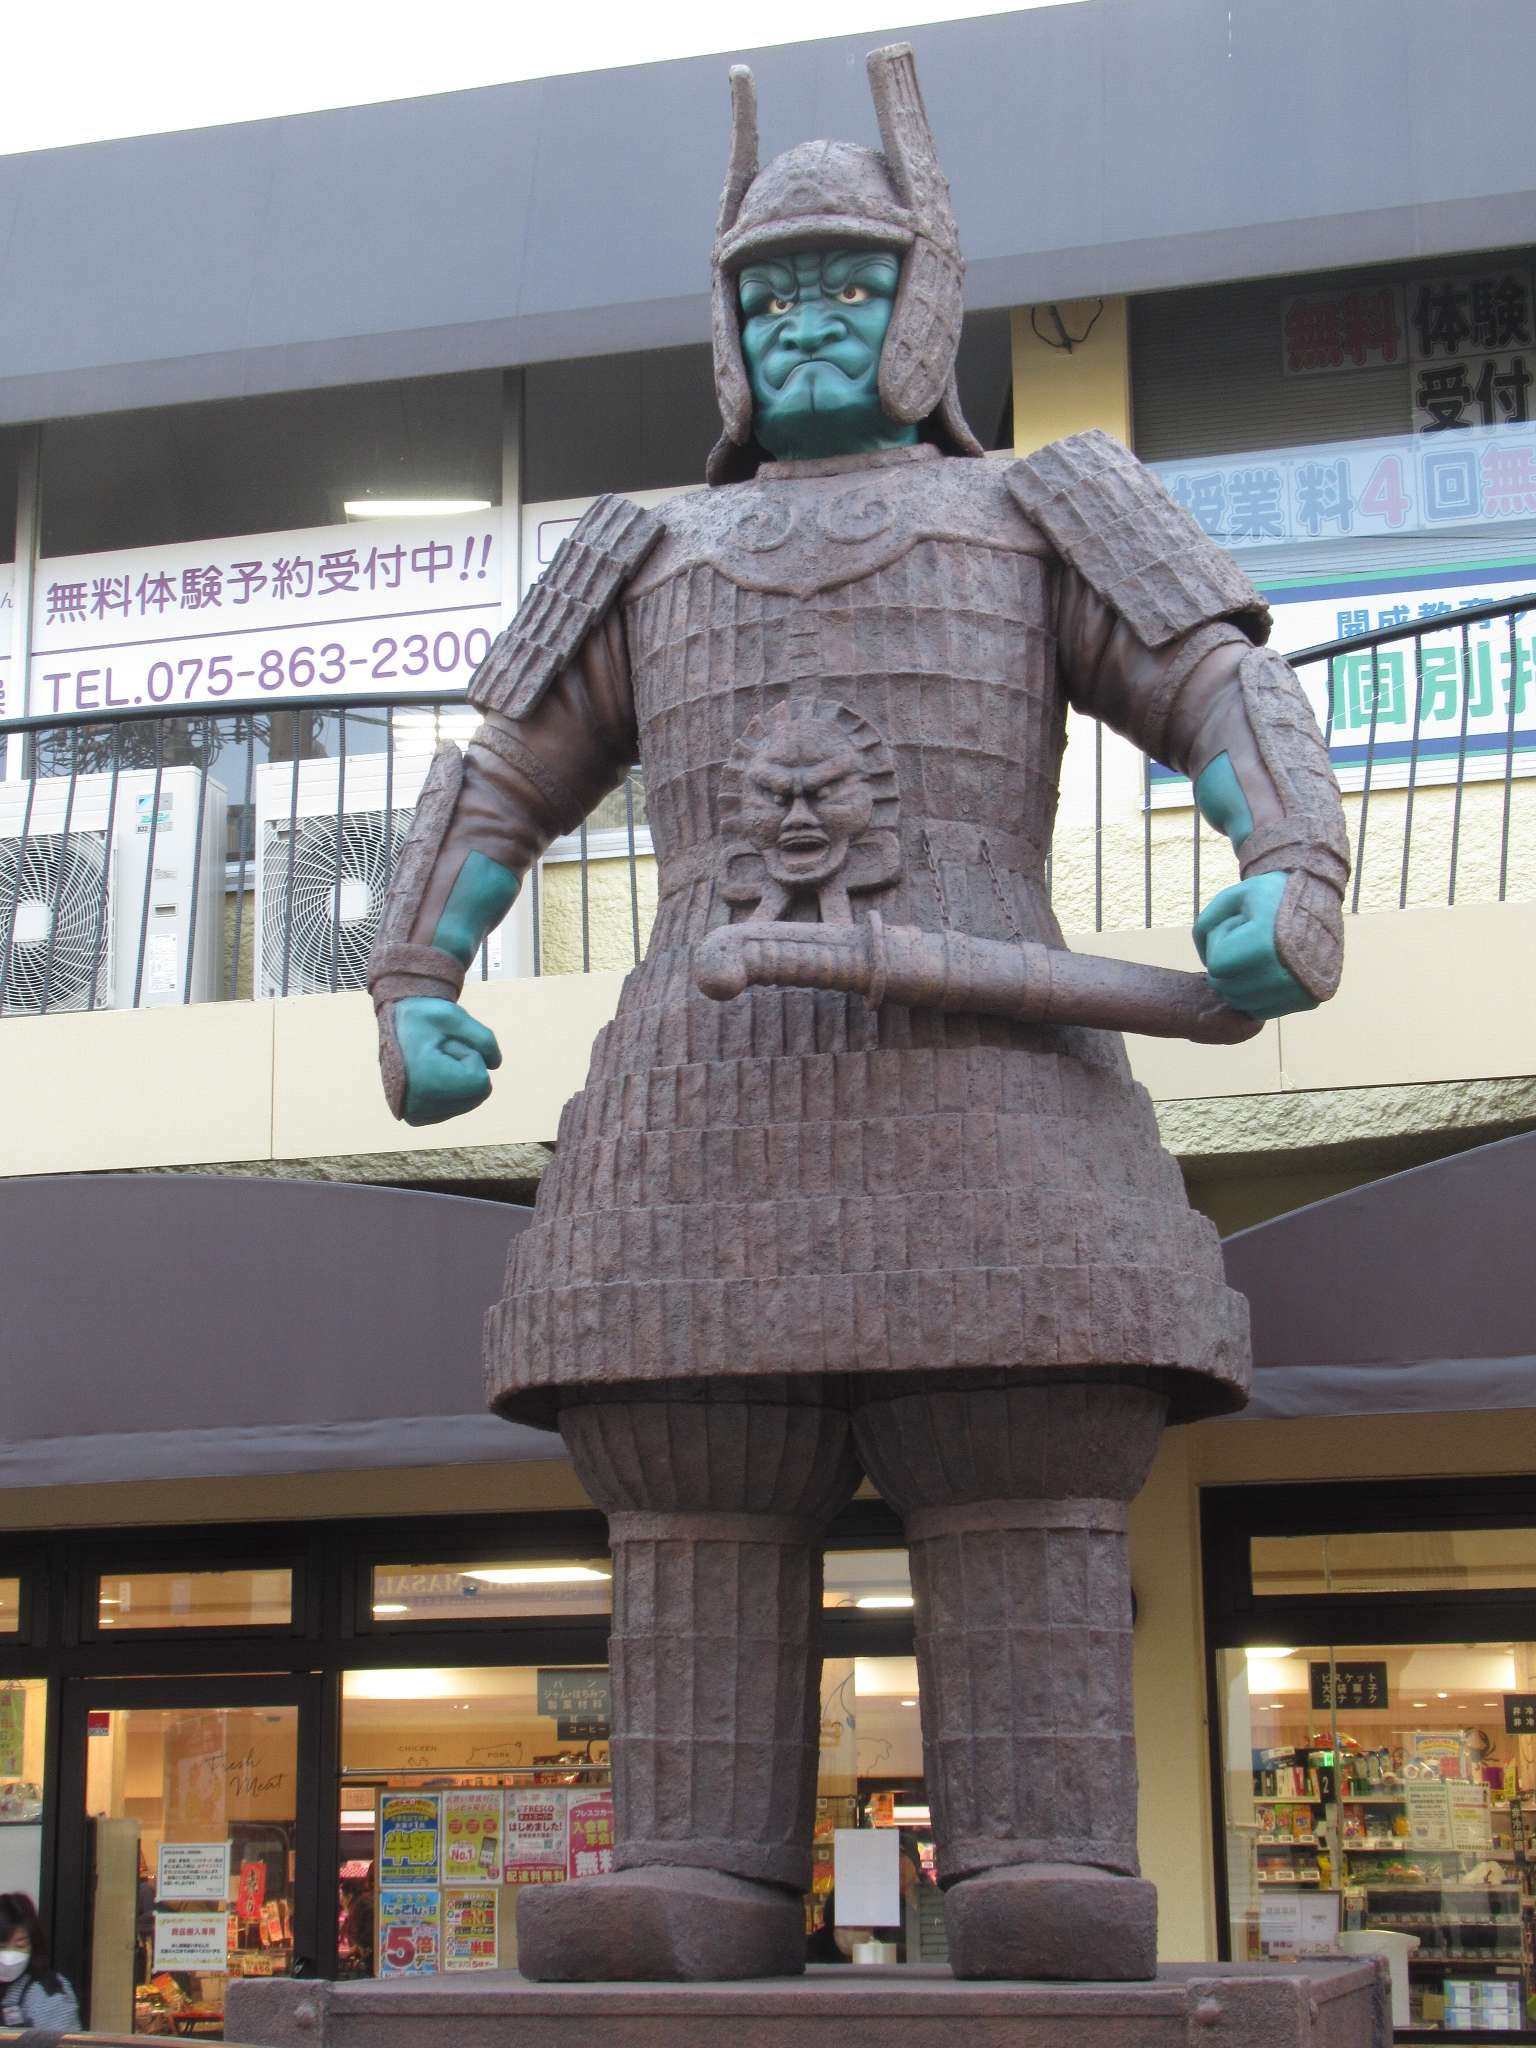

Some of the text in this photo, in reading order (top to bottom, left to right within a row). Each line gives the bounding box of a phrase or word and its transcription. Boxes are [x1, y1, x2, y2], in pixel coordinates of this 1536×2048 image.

[46, 534, 493, 626] 無料体験予約受付中!!
[44, 628, 492, 713] TEL.075-863-2300
